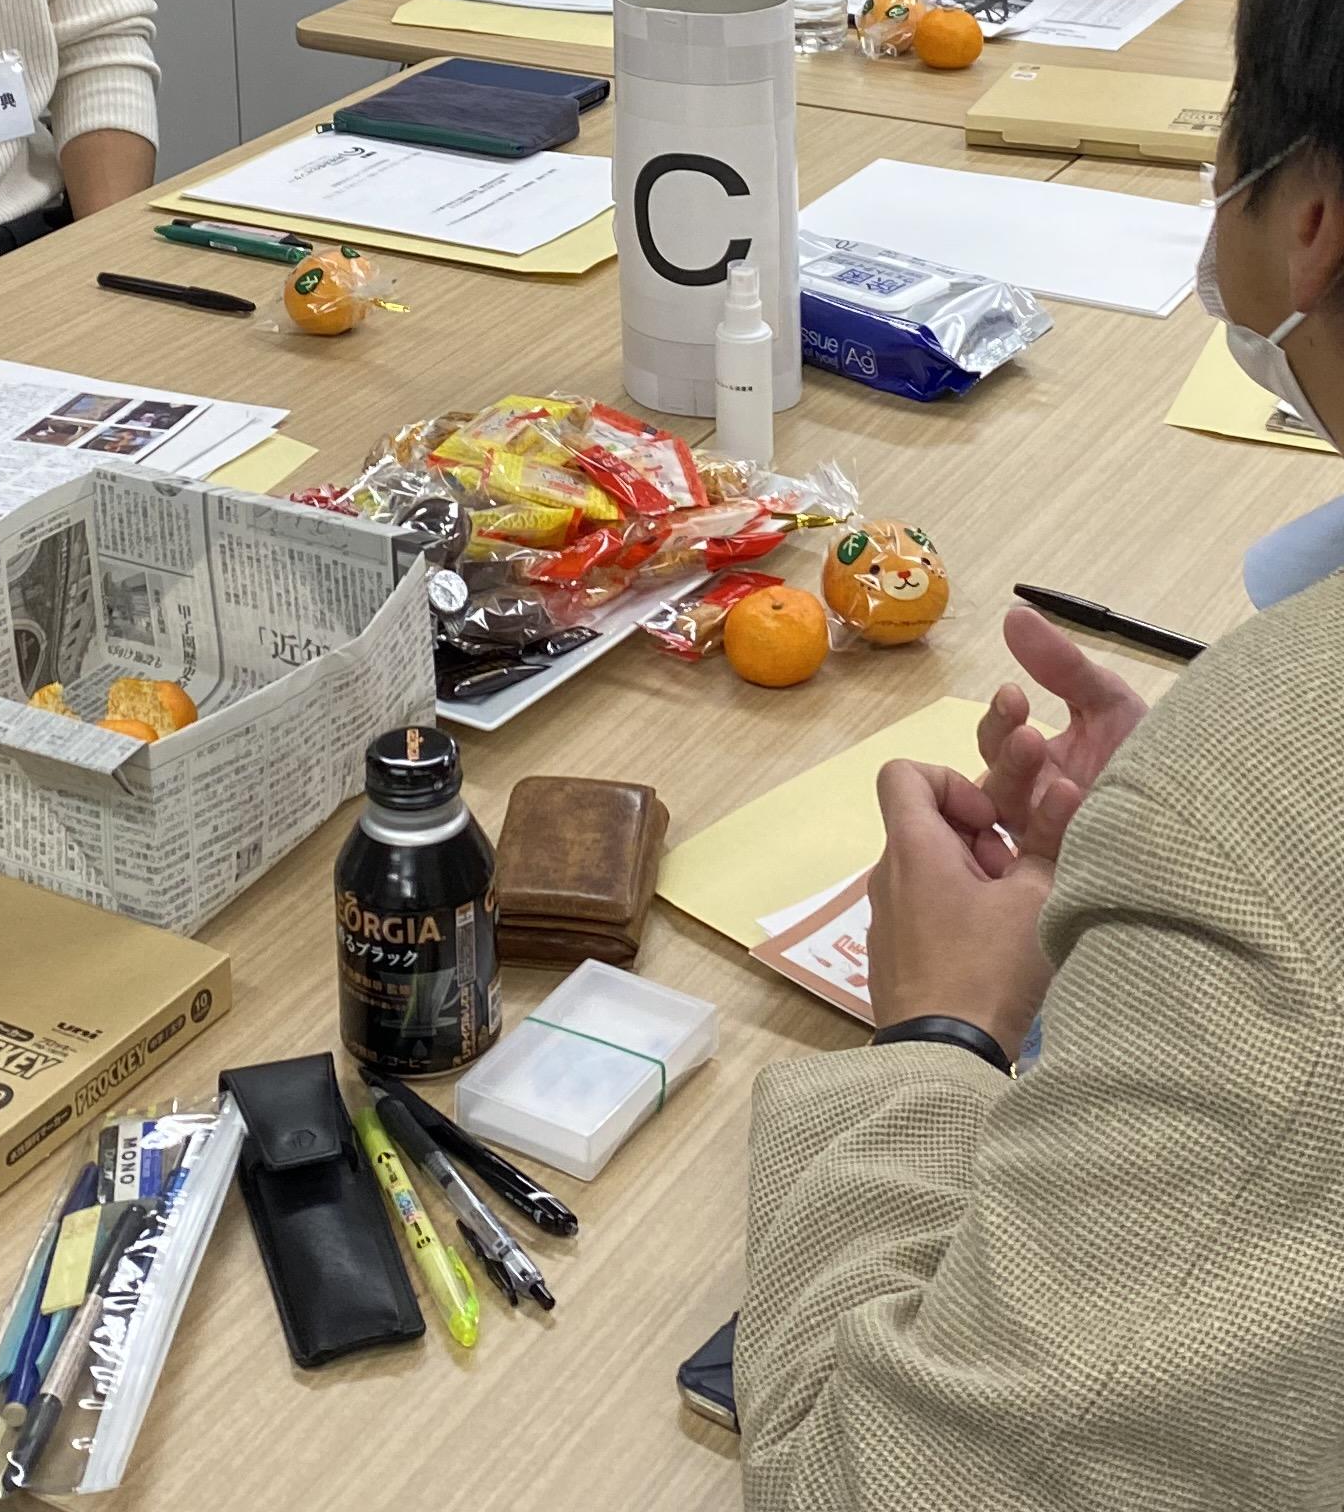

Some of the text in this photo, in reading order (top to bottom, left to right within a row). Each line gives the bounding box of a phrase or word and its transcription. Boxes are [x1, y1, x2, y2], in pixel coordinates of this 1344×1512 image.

[634, 153, 752, 286] C
[337, 890, 443, 946] EORGIA
[195, 993, 207, 1011] 10
[74, 1038, 148, 1117] PROCKEY
[119, 1137, 138, 1185] MONO
